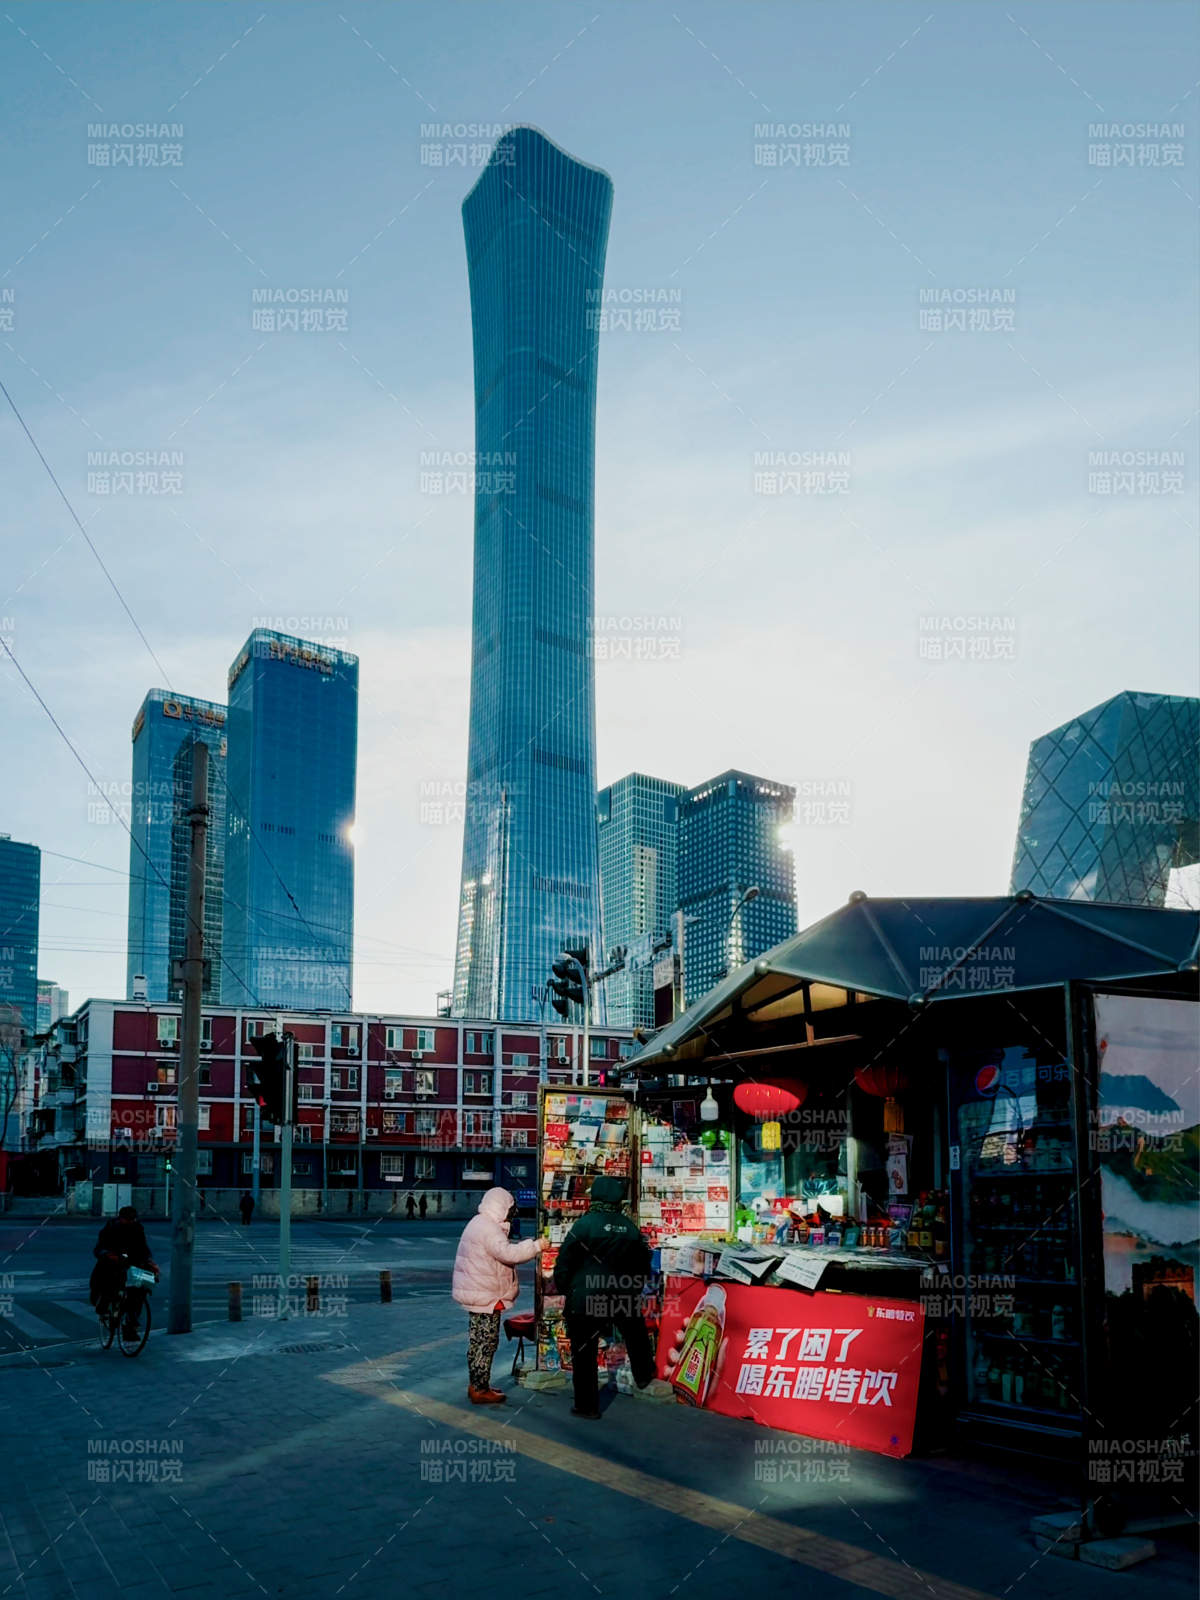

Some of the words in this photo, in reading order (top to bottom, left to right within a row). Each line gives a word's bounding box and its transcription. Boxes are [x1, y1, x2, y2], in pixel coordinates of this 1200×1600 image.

[743, 1328, 864, 1362] 累了困了
[735, 1364, 898, 1406] 喝东鹏特饮
